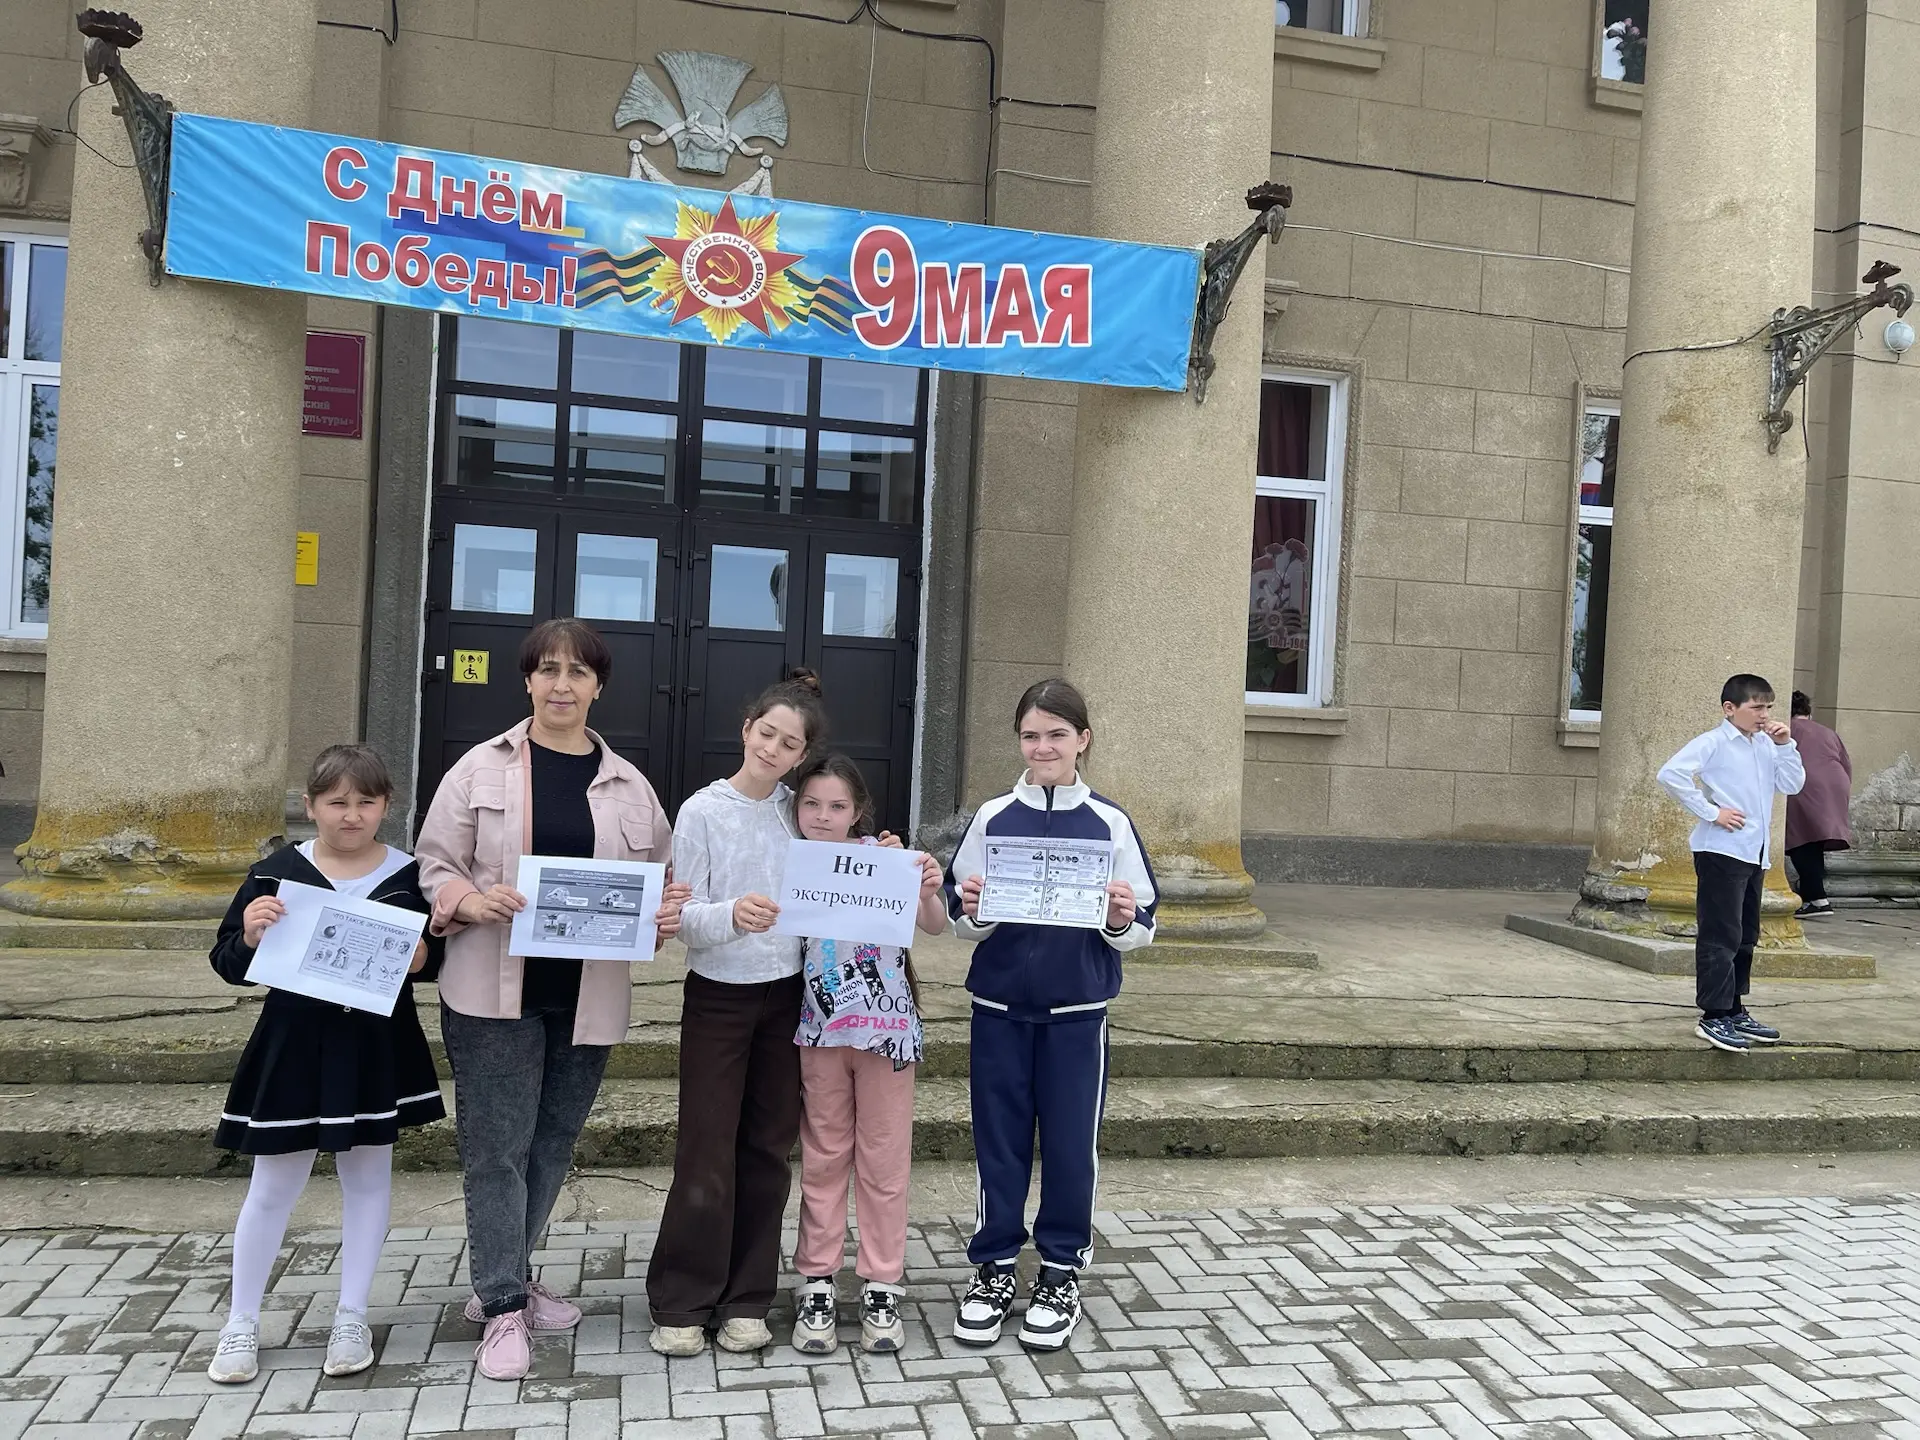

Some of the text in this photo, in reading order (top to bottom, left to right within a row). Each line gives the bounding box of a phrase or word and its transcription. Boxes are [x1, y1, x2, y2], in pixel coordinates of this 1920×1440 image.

[322, 145, 565, 232] С Днём
[305, 220, 580, 310] Победы!
[686, 235, 759, 299] ОТЕЧЕСТВЕННАЯ
[851, 224, 1094, 349] 9 МАЯ
[302, 414, 354, 427] ультуры»
[832, 854, 878, 878] Нет
[790, 887, 908, 916] экстремизму
